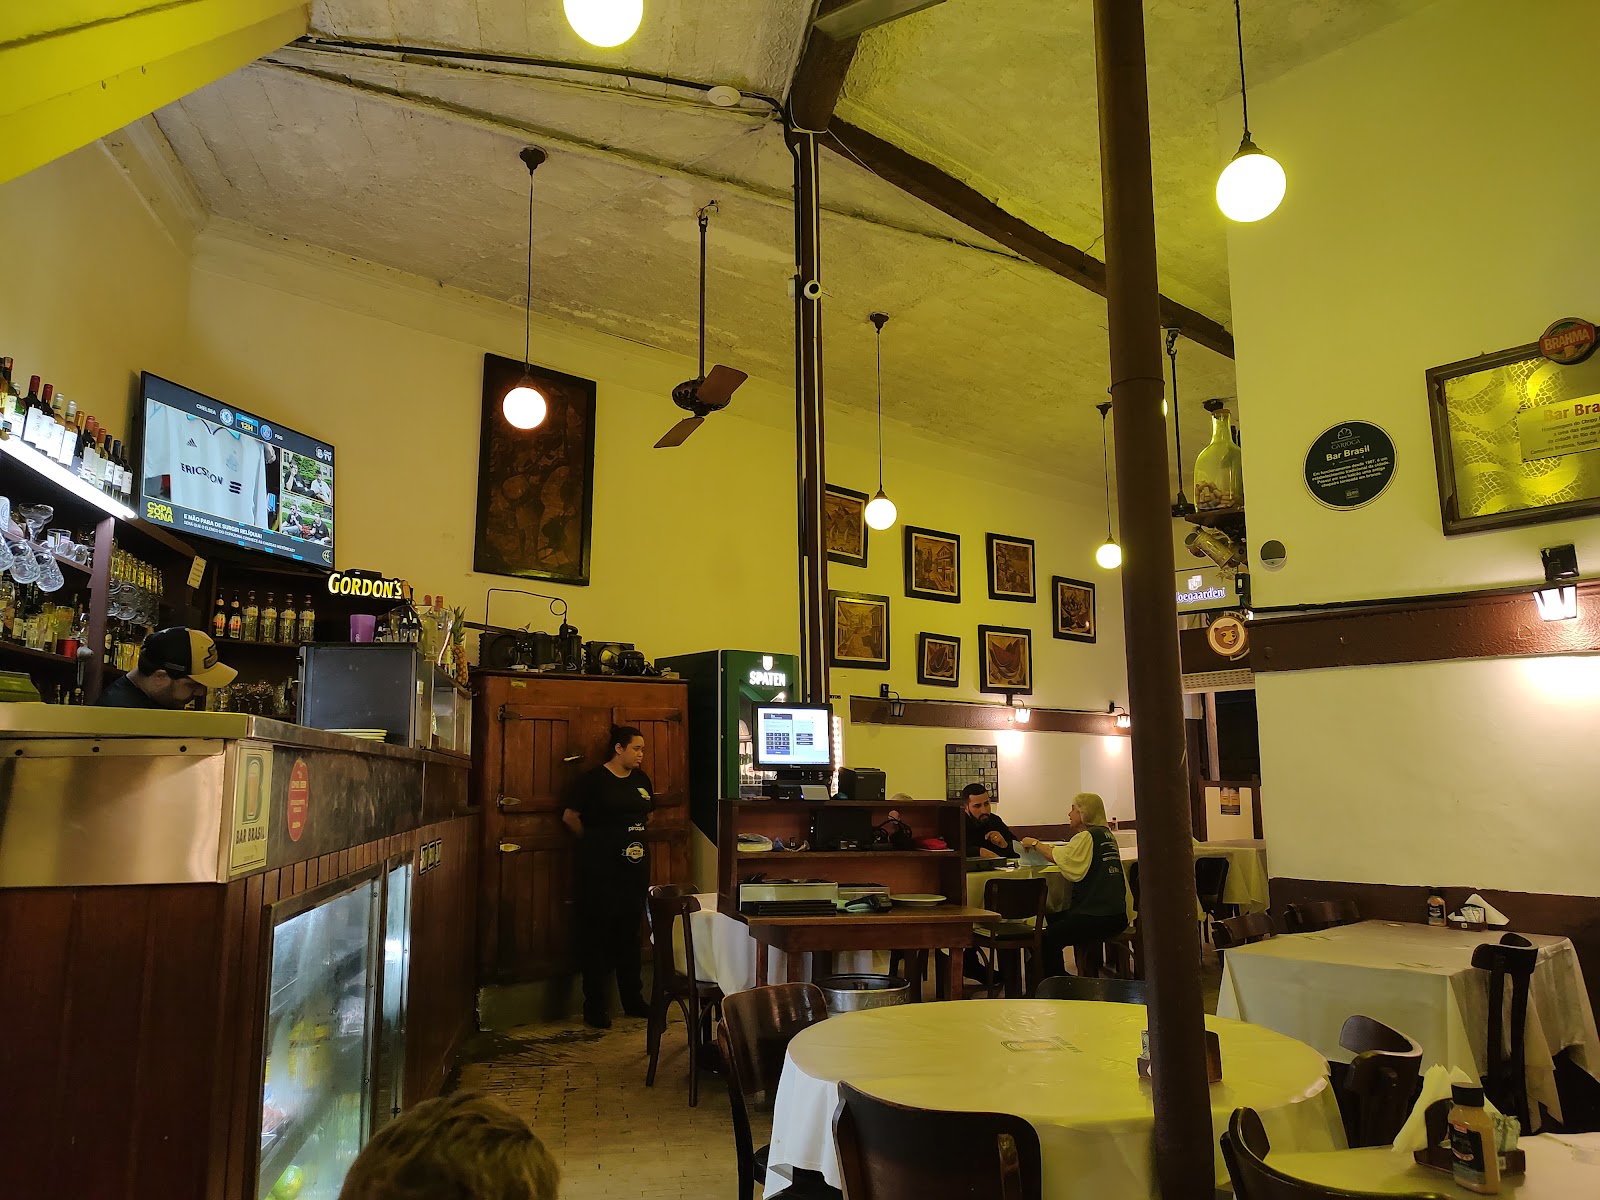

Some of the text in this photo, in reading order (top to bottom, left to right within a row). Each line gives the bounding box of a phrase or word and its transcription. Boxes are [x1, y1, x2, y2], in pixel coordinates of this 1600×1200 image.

[1544, 329, 1591, 351] BRAHMA
[196, 403, 217, 416] CHELSEA
[1543, 403, 1600, 421] Bar Bra
[240, 421, 254, 432] 12H
[1326, 444, 1371, 462] Bar Brasil
[1331, 439, 1361, 450] CARIOCA
[188, 514, 200, 523] NÃO
[200, 518, 214, 527] PARA
[328, 572, 403, 600] GORDON'S
[1176, 587, 1226, 604] oegaarden
[749, 670, 786, 687] SPATEN
[236, 825, 265, 845] BAR BRASIL
